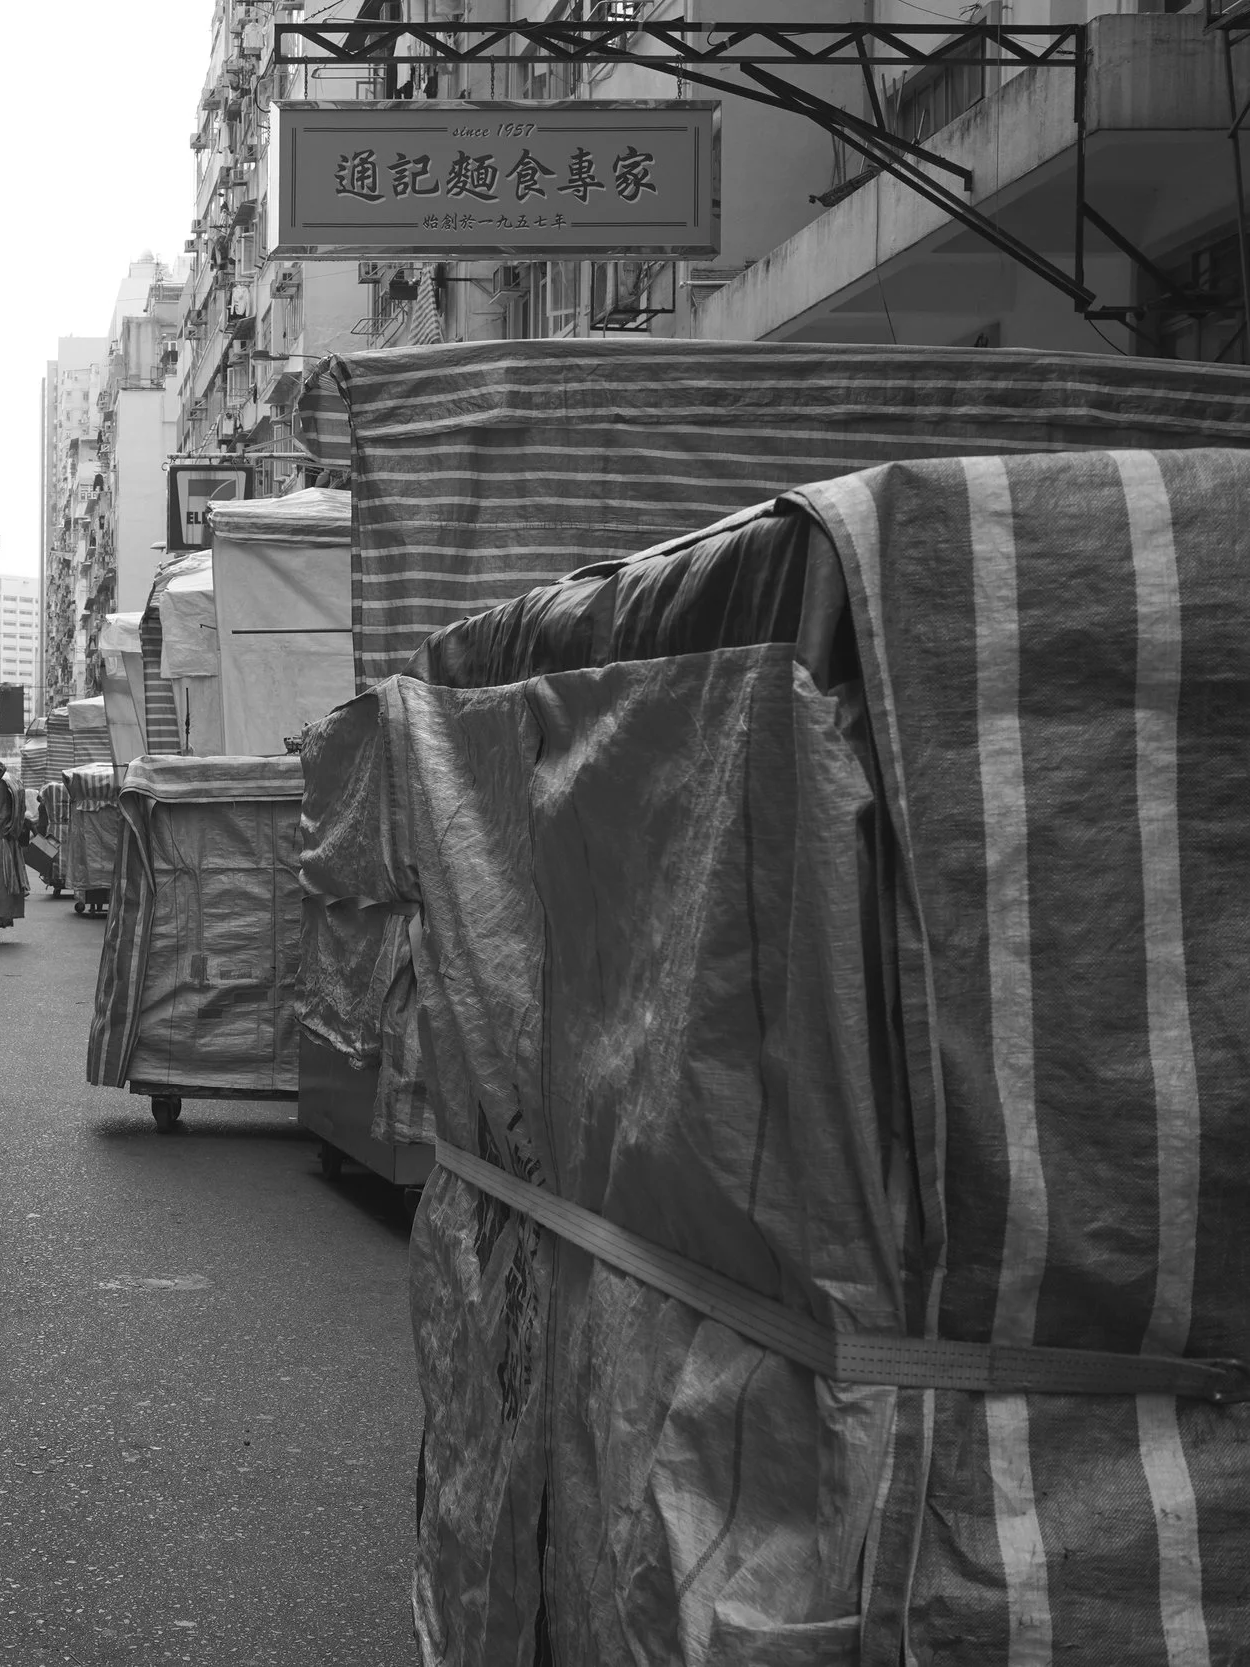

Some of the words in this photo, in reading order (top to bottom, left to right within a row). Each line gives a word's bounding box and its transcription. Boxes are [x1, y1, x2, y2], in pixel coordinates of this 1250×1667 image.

[452, 125, 491, 138] since
[497, 123, 537, 138] 1957
[335, 145, 658, 204] 通記麵食專家
[422, 212, 567, 232] 始創於一九五七年
